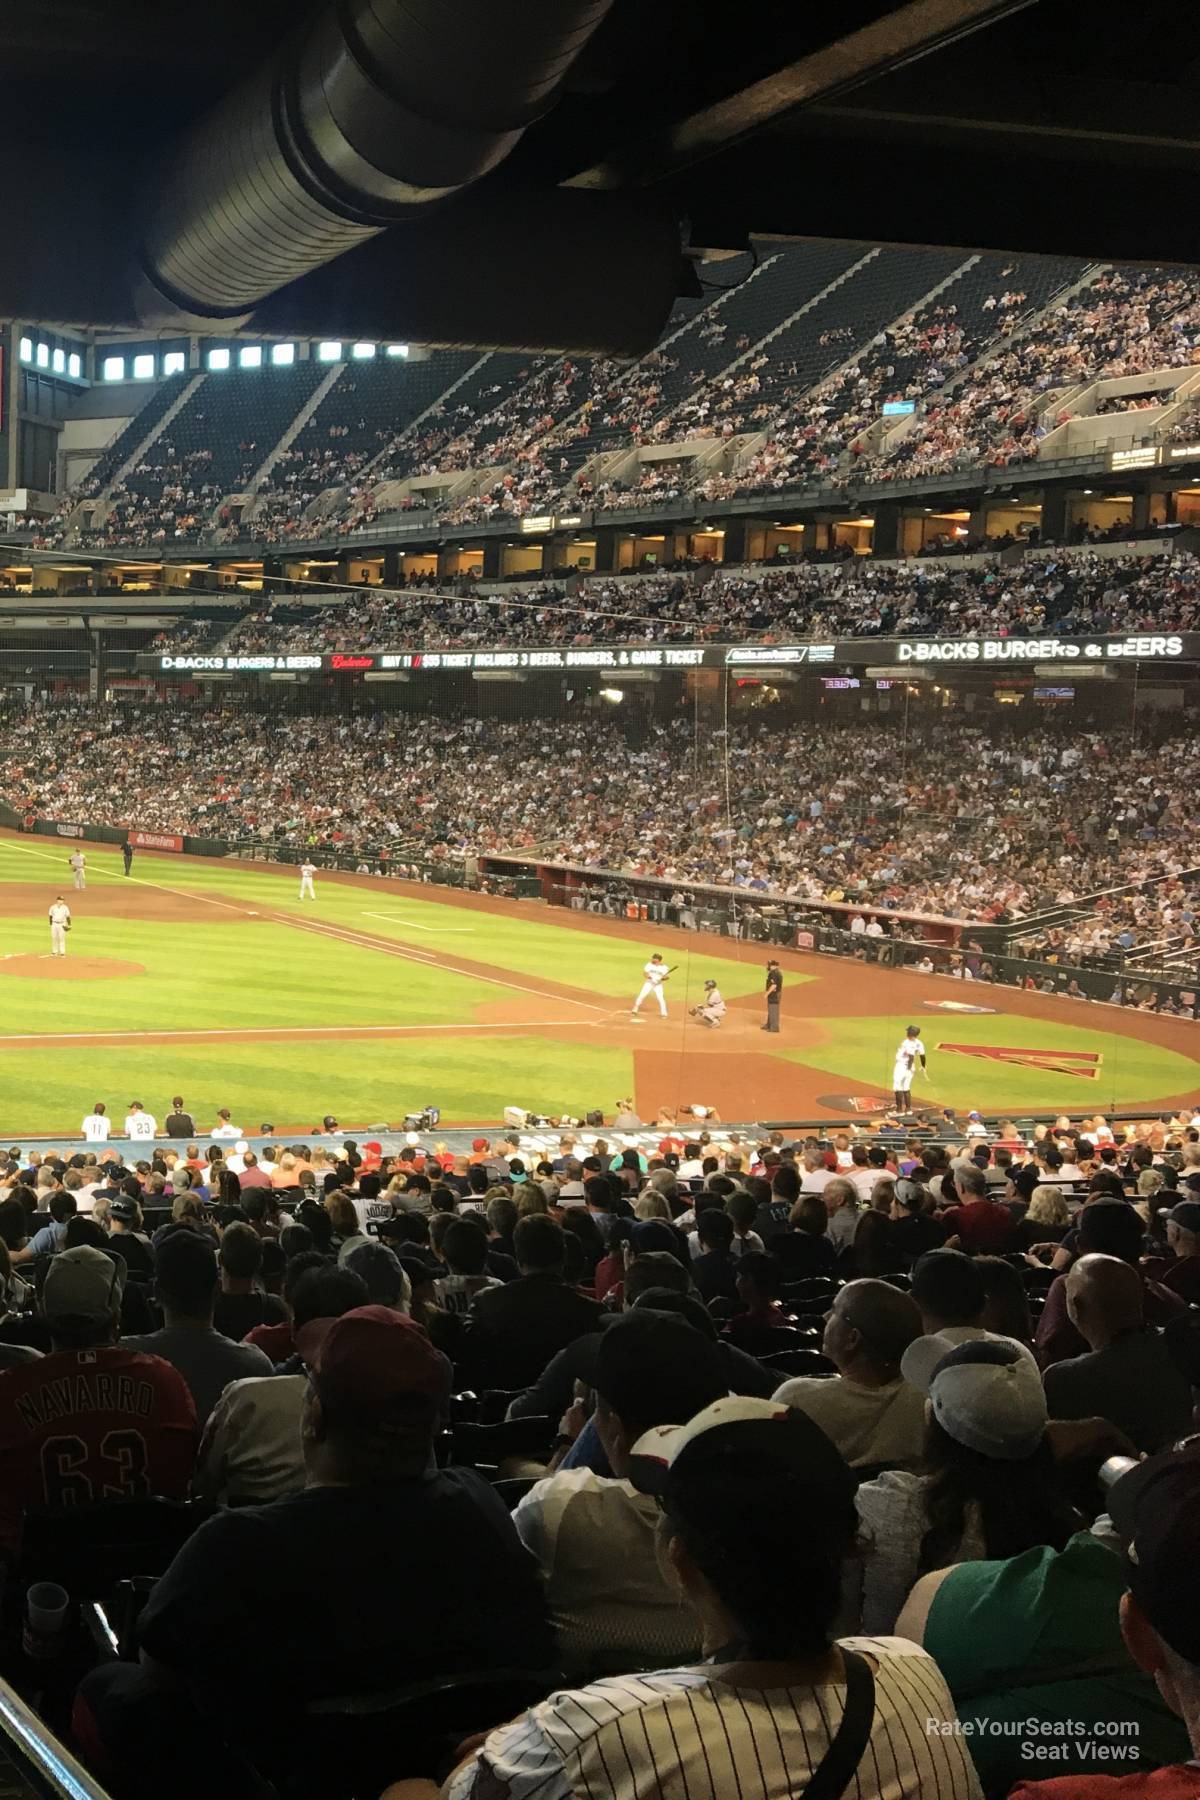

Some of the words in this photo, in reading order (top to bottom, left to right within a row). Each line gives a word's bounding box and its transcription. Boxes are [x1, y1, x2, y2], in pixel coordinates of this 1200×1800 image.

[161, 656, 224, 669] D-BACKS
[227, 656, 275, 669] BURGERS
[276, 657, 285, 668] &
[287, 656, 322, 668] BEERS
[381, 654, 401, 667] MAY
[403, 654, 411, 667] 11
[442, 654, 472, 667] TICKET
[474, 653, 519, 667] INCLUDES
[521, 654, 528, 666] 3
[631, 651, 662, 664] GAME
[665, 650, 705, 664] TICKET
[898, 642, 979, 660] D-BACKS
[136, 1122, 151, 1135] 23
[15, 1374, 155, 1432] NAVARRO
[40, 1428, 151, 1506] 63
